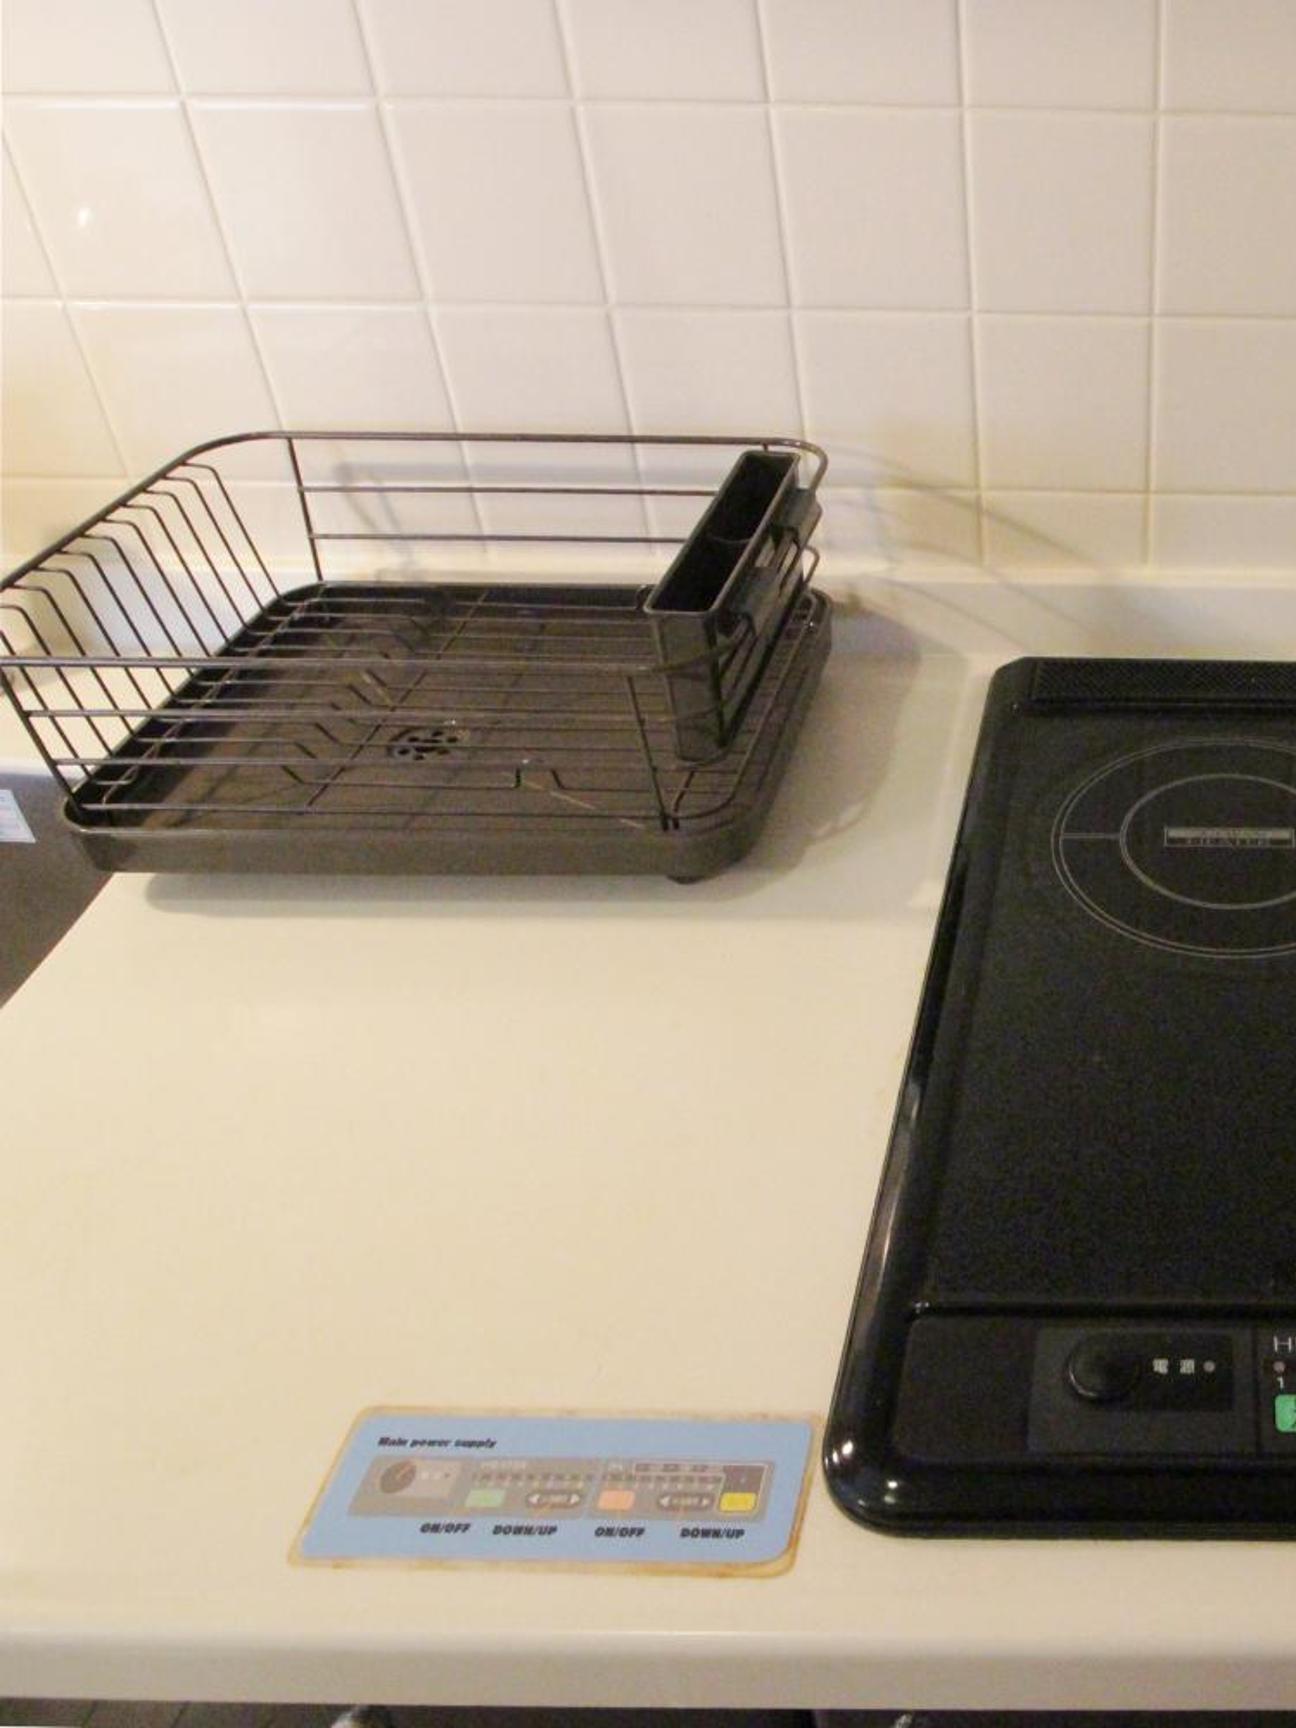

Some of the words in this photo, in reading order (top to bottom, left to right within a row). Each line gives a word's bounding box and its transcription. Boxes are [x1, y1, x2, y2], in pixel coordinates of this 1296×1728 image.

[1275, 1377, 1286, 1391] 1
[377, 1436, 408, 1447] Main
[409, 1439, 451, 1449] power
[454, 1438, 498, 1449] supply
[419, 1522, 472, 1534] ON/OFF
[491, 1524, 559, 1536] DOWN/UP
[594, 1527, 646, 1538] ON/OFF
[679, 1527, 746, 1539] DOWN/UP
